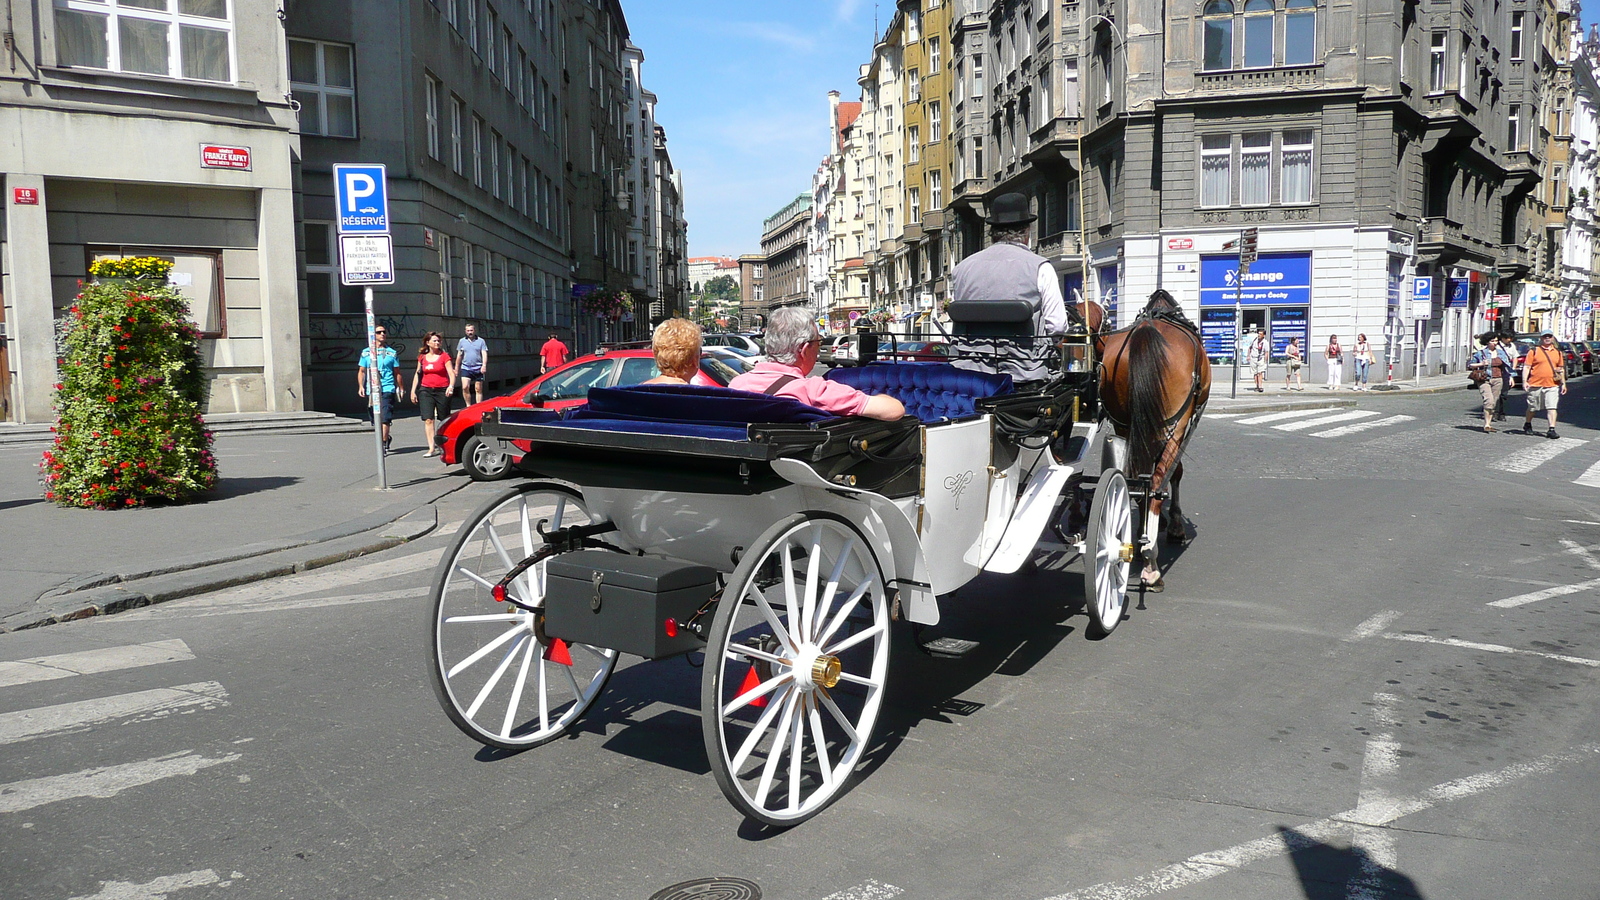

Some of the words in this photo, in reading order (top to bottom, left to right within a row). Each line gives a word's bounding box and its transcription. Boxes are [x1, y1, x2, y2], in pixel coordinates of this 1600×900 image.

[205, 152, 227, 160] FRANZE
[228, 154, 247, 162] KAFKY
[346, 173, 376, 212] P
[342, 215, 385, 226] RÉSERVÉ
[1416, 280, 1428, 294] P
